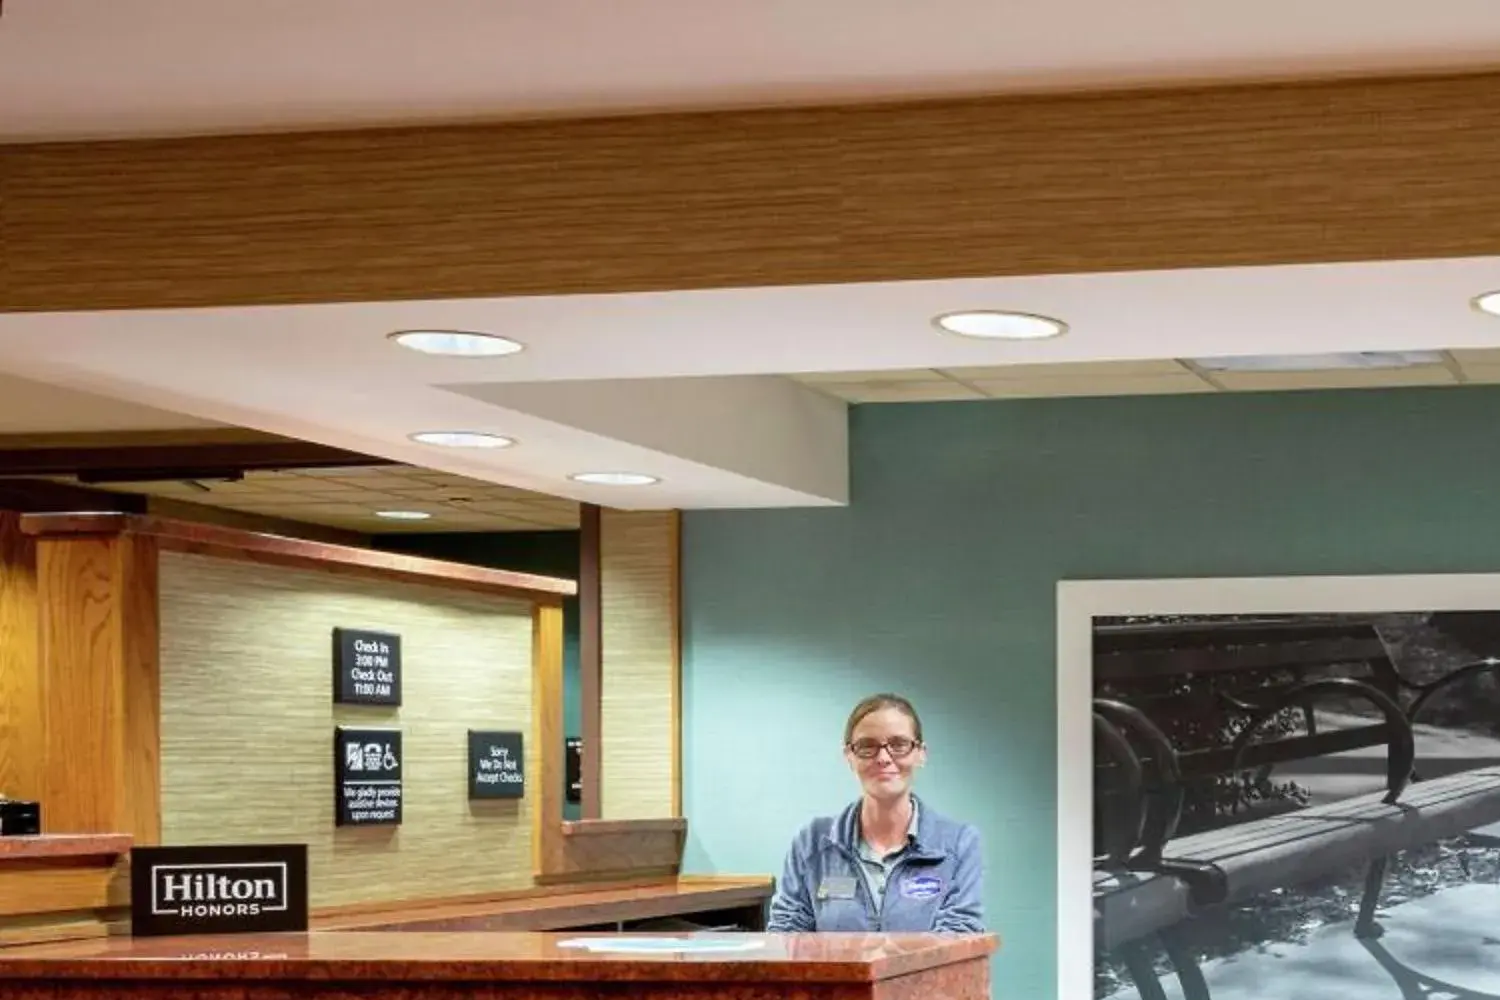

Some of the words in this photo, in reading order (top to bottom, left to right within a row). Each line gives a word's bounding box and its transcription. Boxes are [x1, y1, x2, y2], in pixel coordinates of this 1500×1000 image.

[354, 639, 379, 653] Check
[351, 667, 375, 681] Check
[377, 669, 393, 683] Out
[163, 873, 276, 901] Hilton
[180, 903, 260, 917] HONORS
